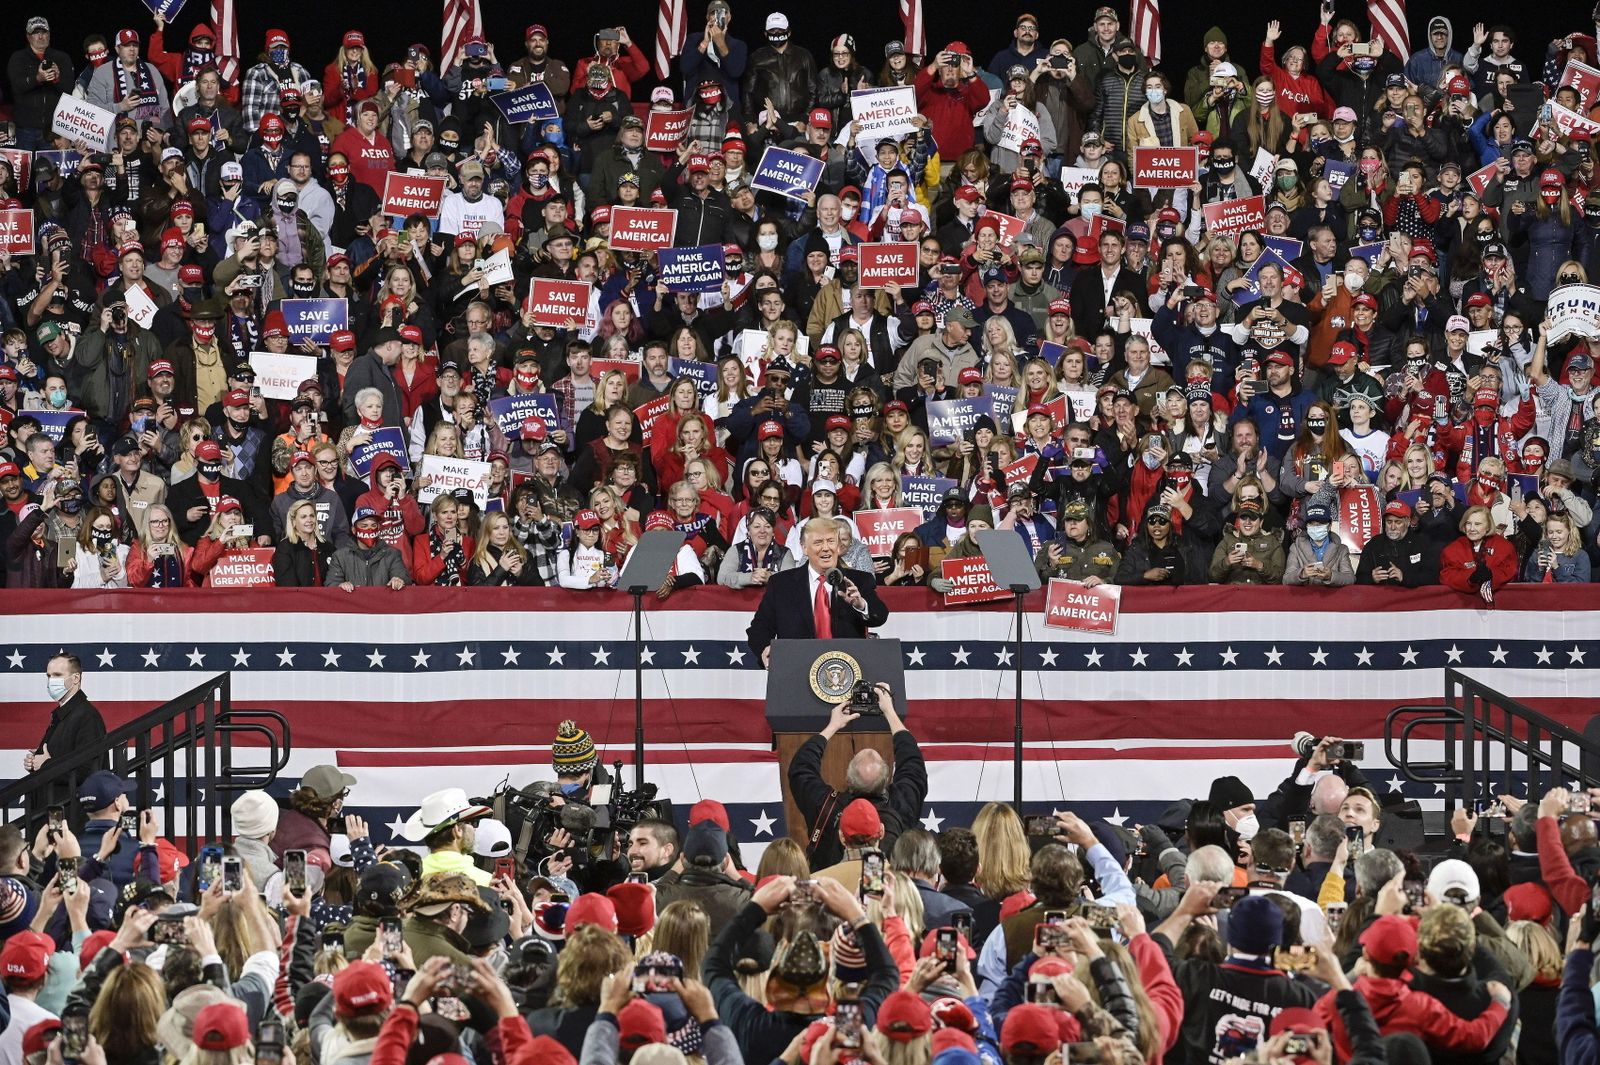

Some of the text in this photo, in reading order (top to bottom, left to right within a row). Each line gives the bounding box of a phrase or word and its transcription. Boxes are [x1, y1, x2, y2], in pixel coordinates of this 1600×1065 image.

[511, 93, 537, 105] SAVE
[1282, 88, 1310, 104] MAGA
[507, 101, 551, 115] AMERICA!
[871, 99, 895, 107] MAKE
[74, 106, 96, 120] MAKE
[815, 112, 827, 121] USA
[858, 107, 912, 121] AMERICA
[57, 110, 105, 136] AMERICA
[55, 120, 105, 144] GREAT AGAIN
[1003, 124, 1039, 141] AMER
[361, 148, 389, 158] AERO
[368, 160, 387, 169] NYC
[691, 158, 707, 166] USA
[776, 159, 804, 174] SAVE
[1152, 158, 1180, 166] SAVE
[760, 168, 812, 189] AMERICA!
[1139, 170, 1193, 179] AMERICA!
[1256, 166, 1264, 181] AKE
[403, 186, 430, 197] SAVE
[388, 197, 439, 210] AMERICA!
[1223, 205, 1247, 214] MAKE
[629, 219, 658, 230] SAVE
[1210, 212, 1263, 230] AMERICA
[614, 230, 669, 242] AMERICA!
[678, 252, 705, 263] MAKE
[876, 254, 903, 263] SAVE
[663, 260, 721, 278] AMERICA
[863, 267, 914, 277] AMERICA!
[664, 272, 722, 286] GREAT AGAIN
[548, 291, 575, 302] SAVE
[533, 304, 585, 316] AMERICA!
[1552, 308, 1600, 322] PENCE
[299, 311, 329, 321] SAVE
[287, 323, 343, 334] AMERICA!
[679, 368, 704, 380] MAKE
[261, 377, 299, 387] MERIC
[992, 392, 1016, 402] MAKE
[1190, 390, 1207, 400] 2020
[512, 400, 538, 409] MAKE
[947, 405, 973, 414] MAKE
[498, 407, 555, 425] AMERICA
[363, 441, 394, 453] DEFEND
[355, 450, 403, 465] DEMACY!
[442, 465, 468, 475] MAKE
[428, 474, 484, 490] AMERICA
[909, 483, 936, 494] MAKE
[902, 494, 943, 504] MERIC
[582, 512, 599, 520] USA
[1350, 502, 1358, 533] SAVE
[873, 520, 904, 531] SAVE
[861, 536, 895, 545] AMERI
[230, 554, 255, 562] MAKE
[214, 564, 275, 576] AMERICA
[216, 574, 276, 586] GREAT AGAIN
[947, 573, 991, 586] AMERI
[947, 585, 1003, 596] GREAT AGA
[1067, 595, 1098, 607] SAVE
[1051, 606, 1112, 622] AMERICA!
[7, 963, 25, 973] USA
[1252, 1002, 1270, 1016] FOR
